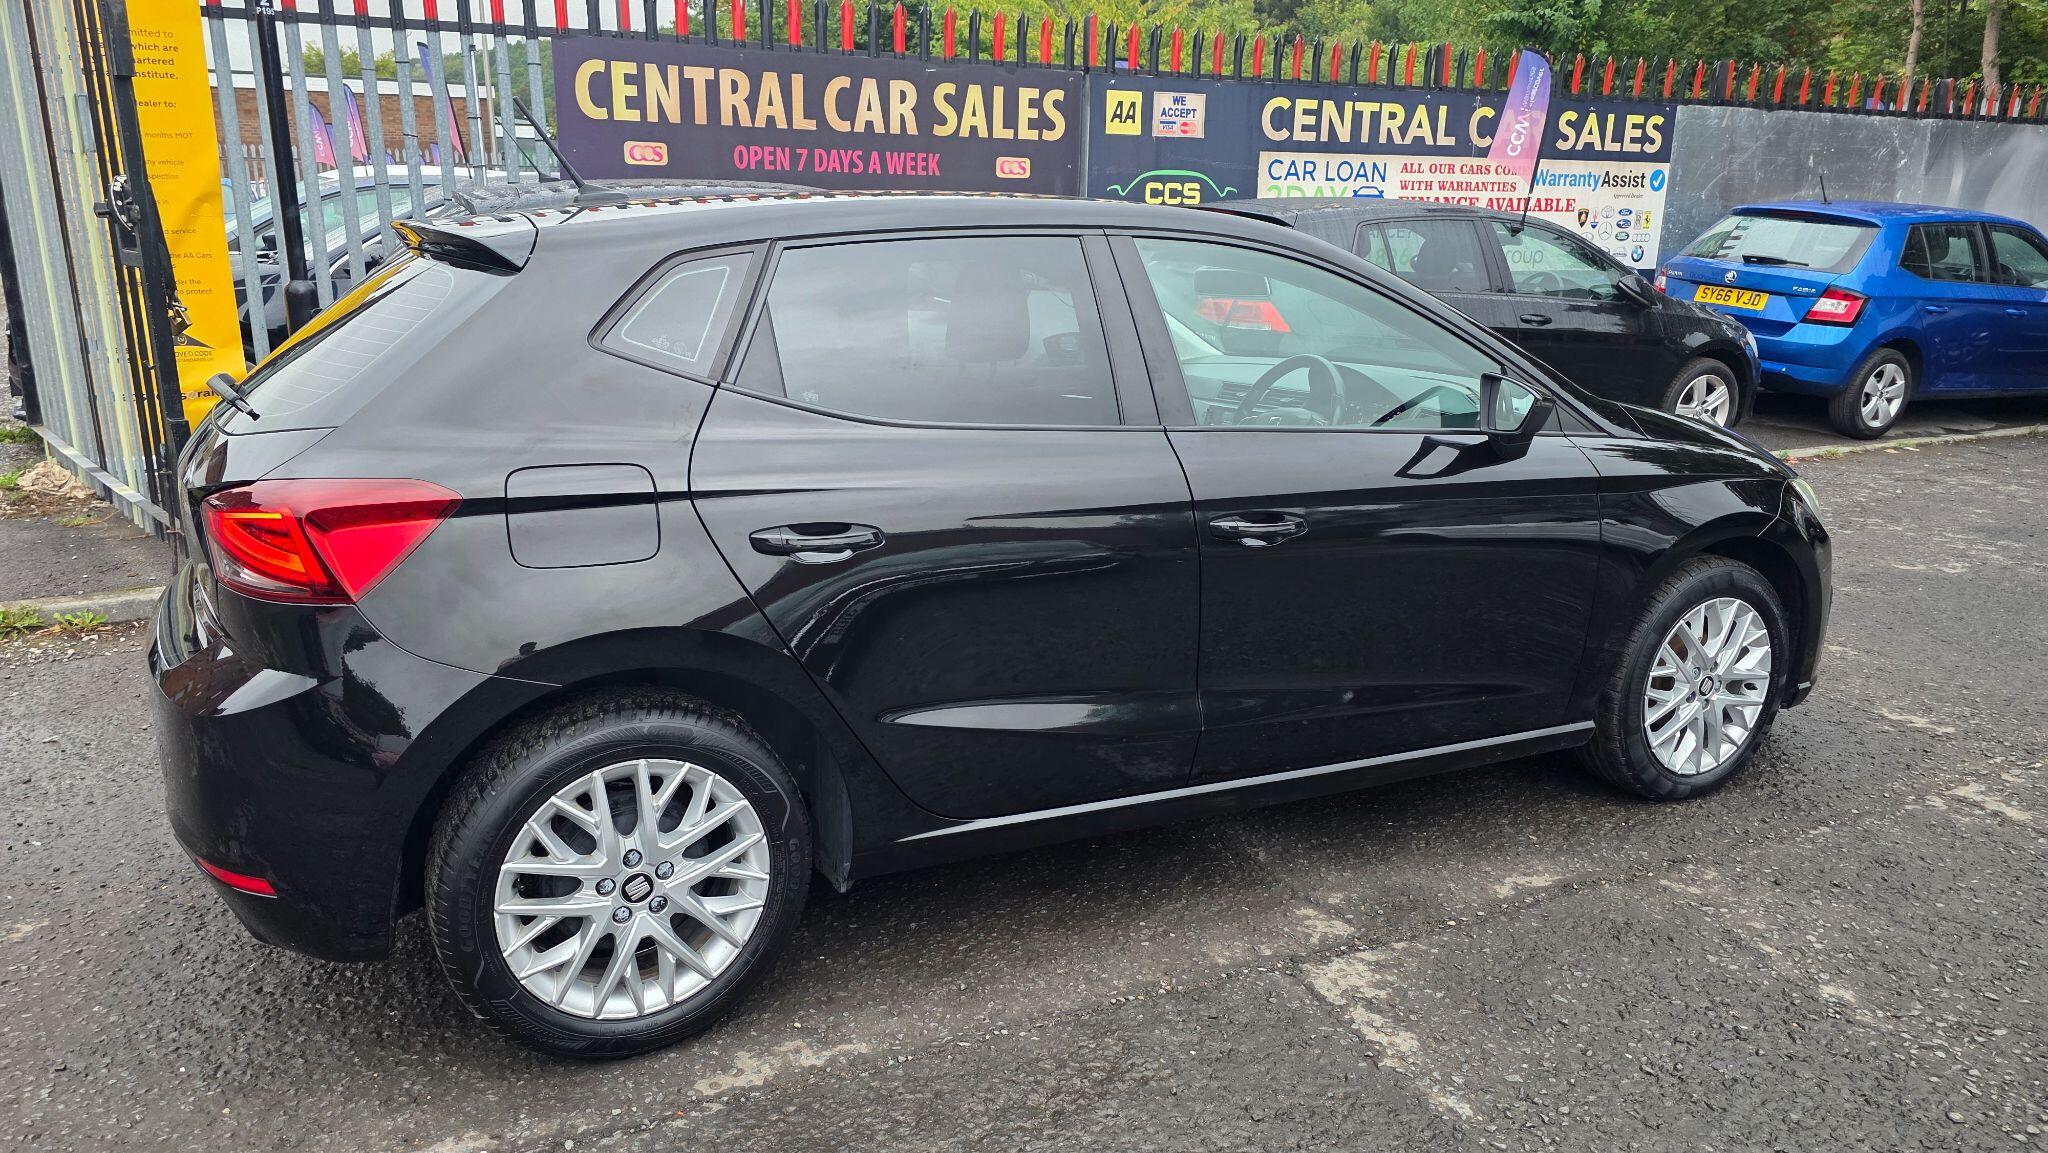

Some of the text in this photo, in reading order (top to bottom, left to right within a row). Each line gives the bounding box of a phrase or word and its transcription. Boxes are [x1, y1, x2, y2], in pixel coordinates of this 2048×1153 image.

[163, 29, 174, 38] to
[163, 100, 177, 108] to:
[574, 58, 1066, 142] CENTRAL CAR SALES
[1172, 95, 1187, 106] WE
[1110, 100, 1137, 124] AA
[1160, 107, 1198, 118] ACCEPT
[1261, 96, 1456, 146] CENTRAL
[1555, 110, 1665, 154] SALES
[1506, 111, 1532, 157] CCM
[733, 144, 941, 176] OPEN 7 DAYS A WEEK
[1268, 158, 1387, 183] CAR LOAN
[1400, 162, 1425, 174] ALL
[1429, 163, 1456, 175] OUR
[1460, 164, 1491, 175] CARS
[1145, 181, 1201, 205] CCS
[1400, 180, 1517, 192] WITH WARRANTIES
[1701, 287, 1762, 306] SY66 VJD
